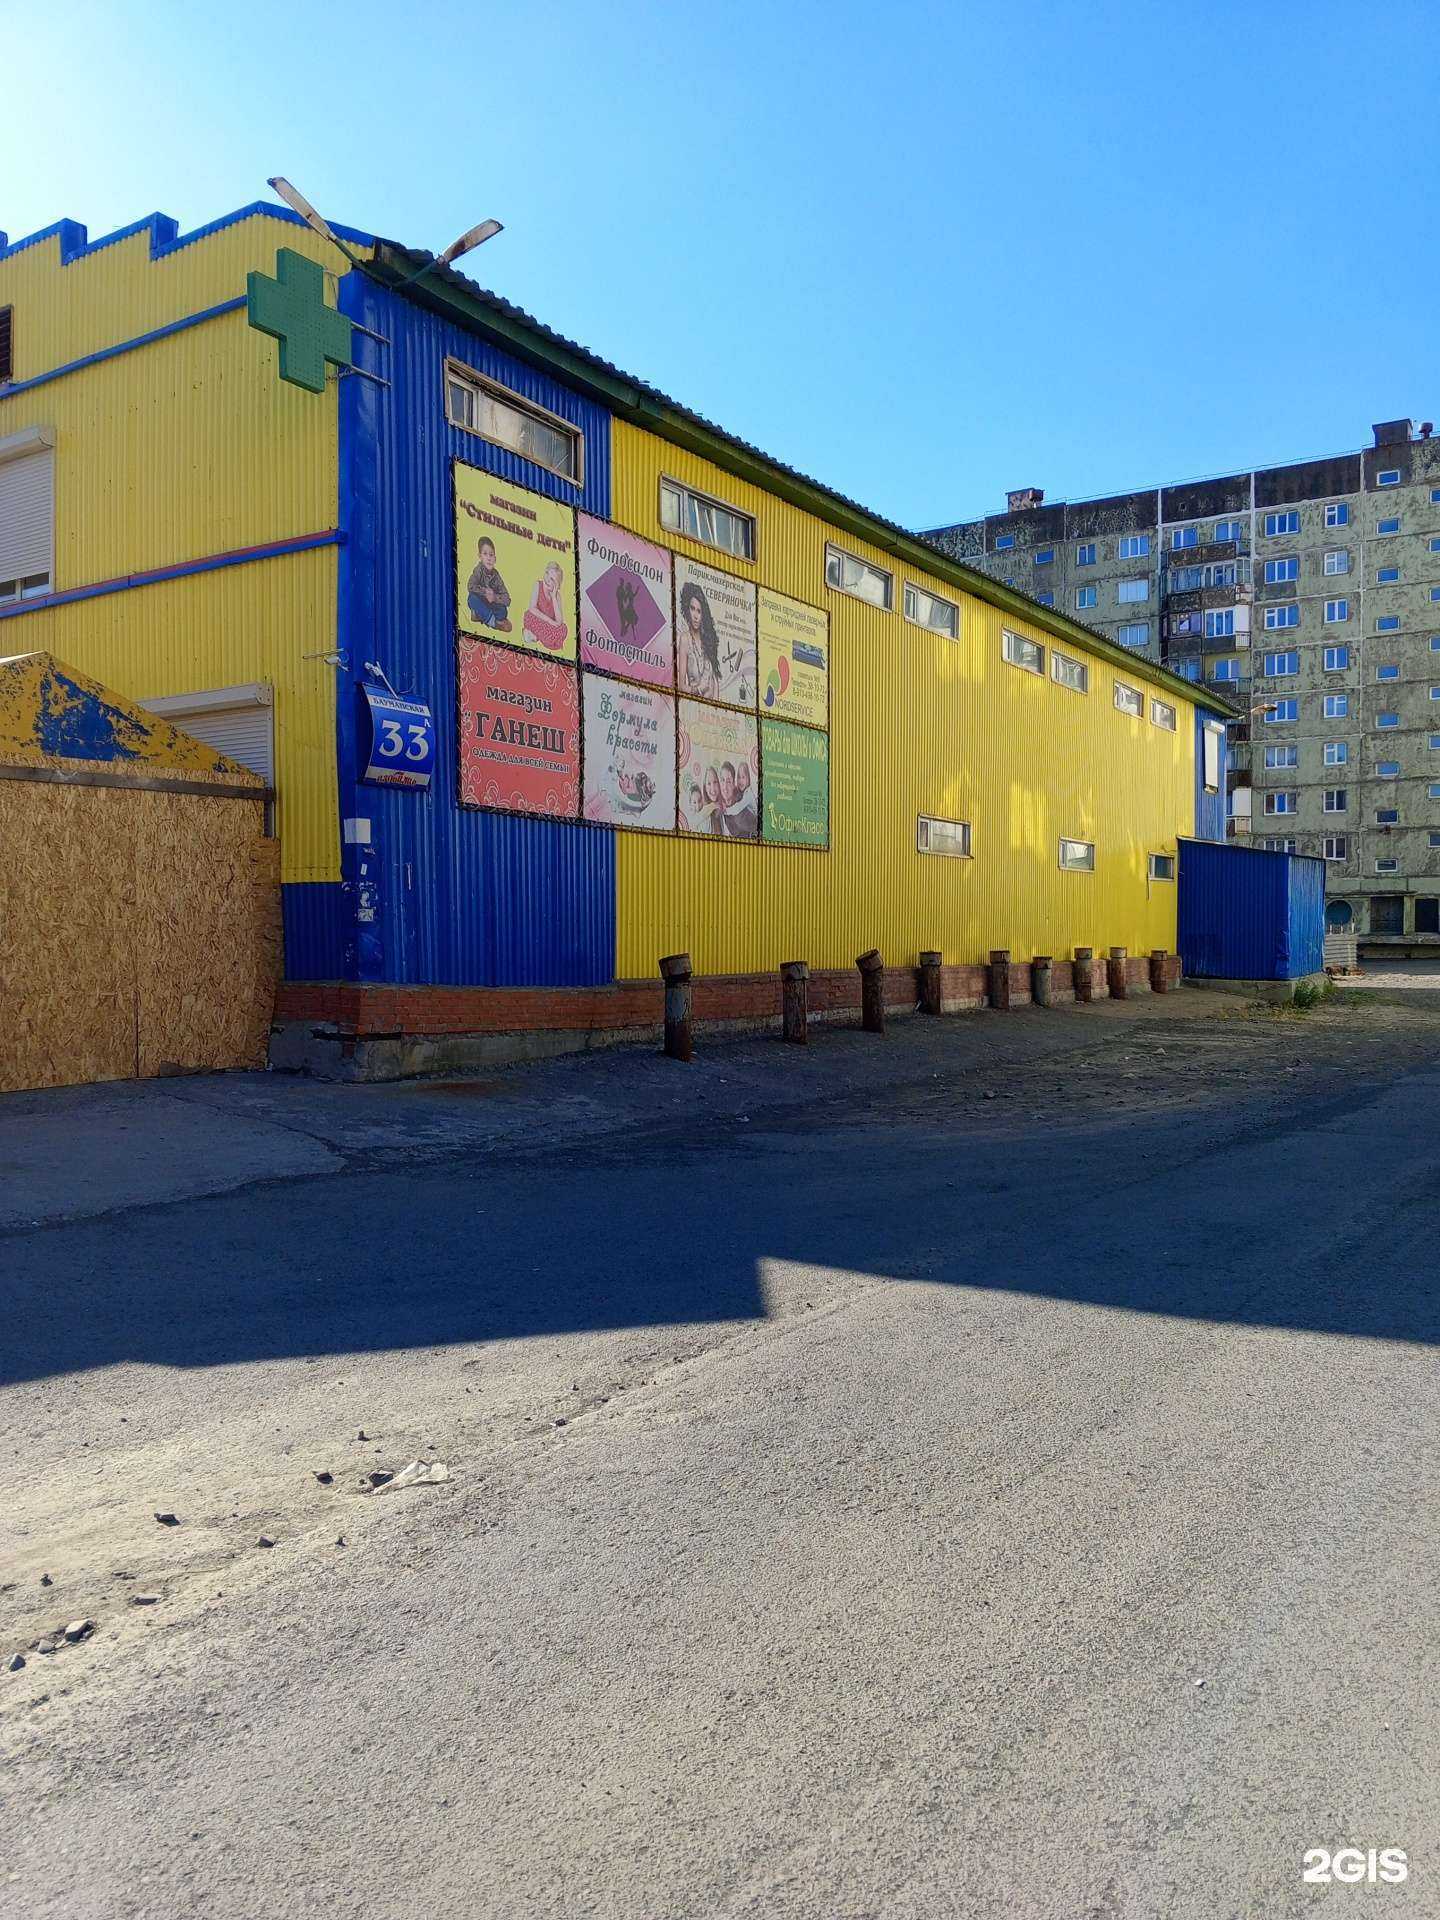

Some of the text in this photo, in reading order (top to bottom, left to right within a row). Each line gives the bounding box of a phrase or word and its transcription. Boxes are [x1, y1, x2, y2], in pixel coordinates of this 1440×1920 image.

[587, 538, 663, 583] Фотосалон
[586, 629, 666, 668] Фотостиль
[486, 686, 552, 713] магазин
[597, 693, 657, 736] Формула
[379, 720, 429, 761] 33
[606, 724, 657, 756] красоты
